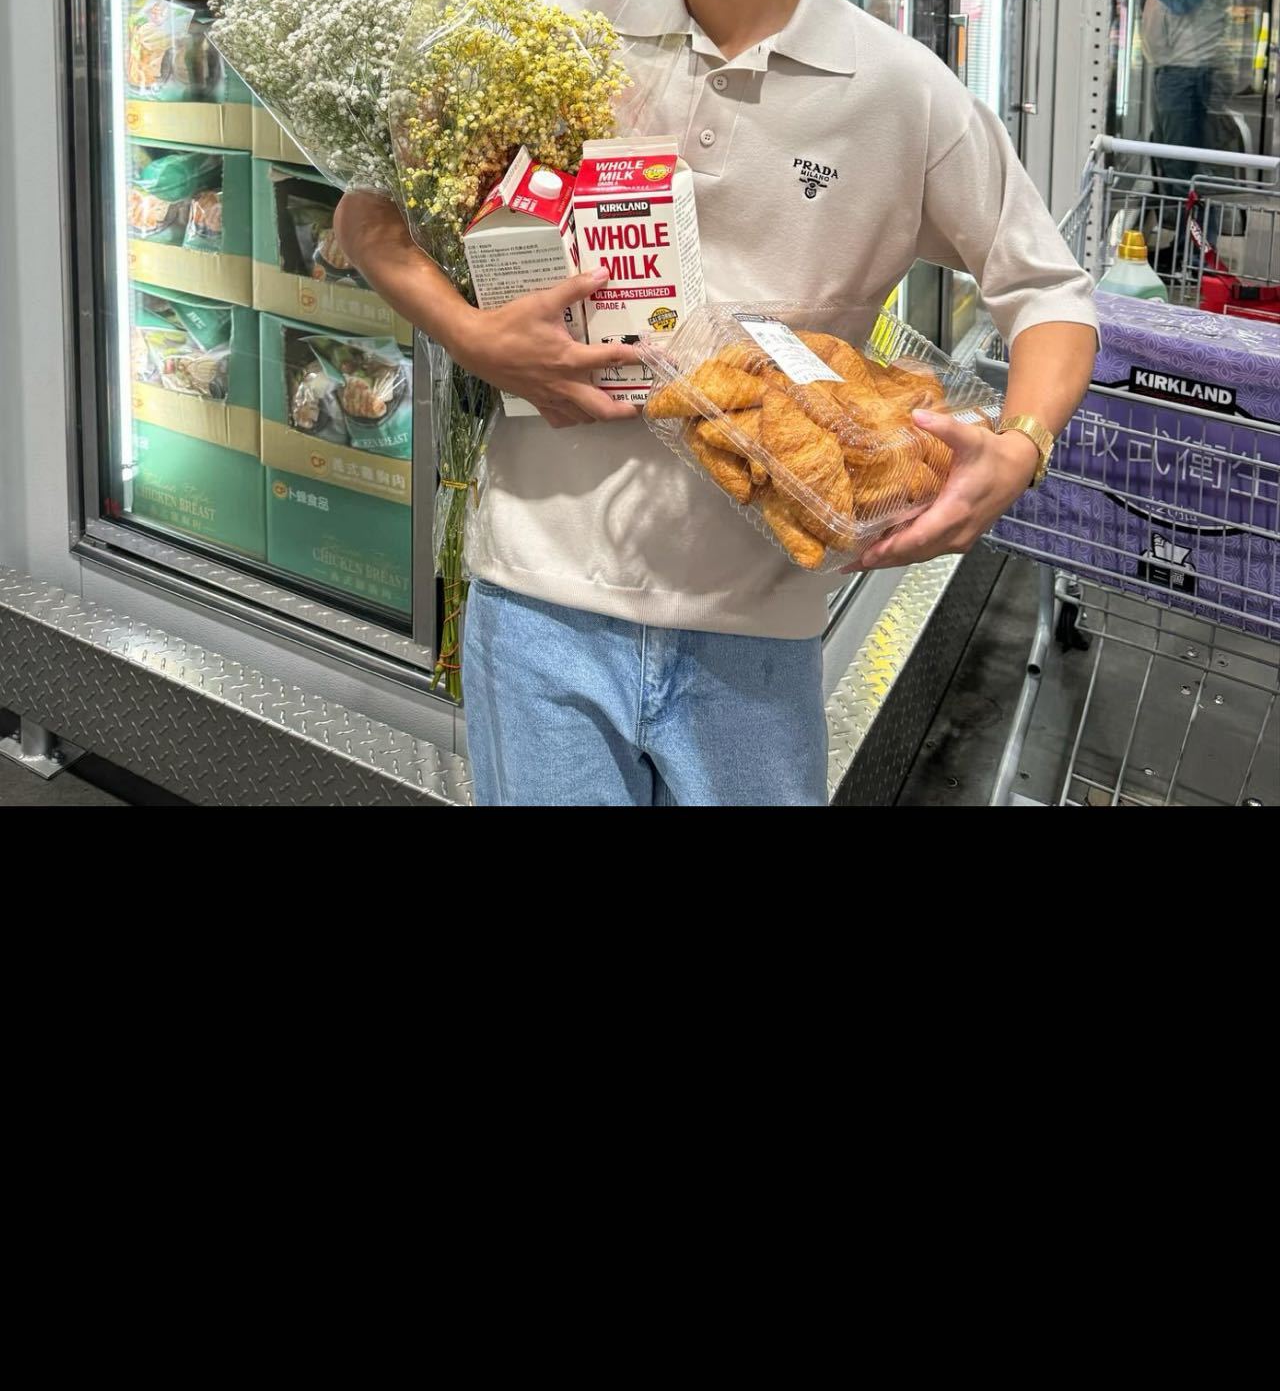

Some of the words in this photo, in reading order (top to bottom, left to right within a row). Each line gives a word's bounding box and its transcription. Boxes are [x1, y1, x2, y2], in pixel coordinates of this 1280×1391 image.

[595, 160, 644, 172] WHOLE
[793, 158, 839, 180] PRADA
[598, 171, 634, 182] MILK
[800, 169, 830, 182] MILANO
[599, 201, 649, 213] KIRKLAND
[584, 223, 670, 251] WHOLE
[600, 254, 662, 281] MILK
[594, 287, 670, 300] ULTRA-PASTEURIZED
[595, 302, 619, 311] GRADE
[620, 301, 627, 310] A
[1135, 370, 1233, 405] KIRKLAND
